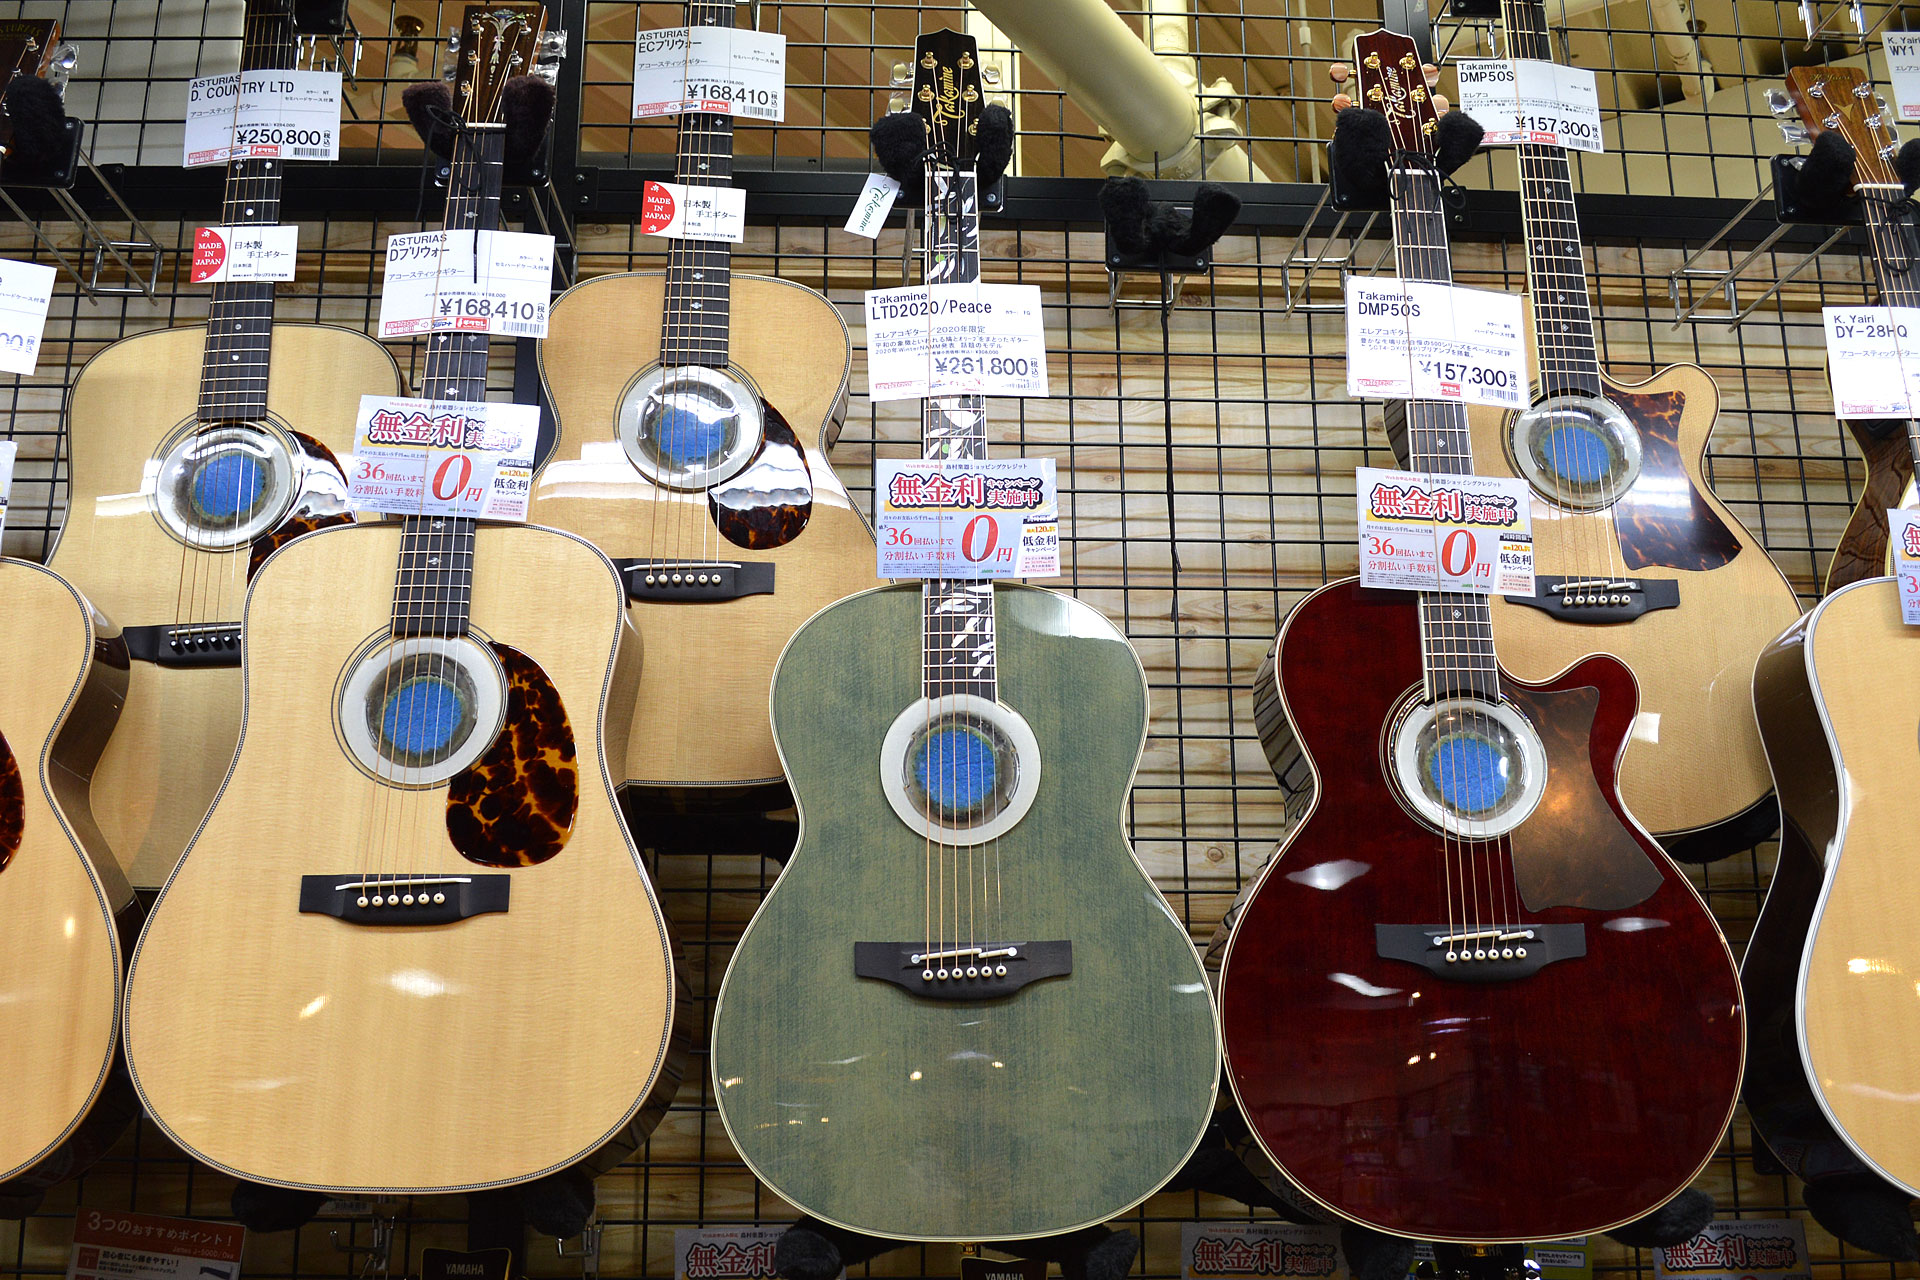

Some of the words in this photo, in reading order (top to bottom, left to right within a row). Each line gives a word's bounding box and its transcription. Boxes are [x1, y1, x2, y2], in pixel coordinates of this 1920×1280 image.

[639, 30, 689, 41] ASTURIAS
[1889, 45, 1915, 56] WY1
[1459, 62, 1508, 71] Takamine
[191, 74, 241, 89] ASTURIAS
[1460, 71, 1515, 83] DMP50S
[206, 81, 266, 99] COUNTRY
[269, 81, 295, 93] LTD
[687, 84, 769, 105] ¥168,410
[933, 65, 966, 127] Takamine
[190, 103, 258, 117] アコースティックギター
[1515, 116, 1591, 138] ¥157,300
[236, 129, 321, 146] ¥250,800
[647, 196, 671, 205] MADE
[683, 200, 711, 209] 日本製
[858, 183, 891, 232] Takamine
[644, 212, 671, 220] JAPAN
[696, 210, 737, 219] 手工ギター
[234, 240, 263, 250] 日本製
[390, 233, 448, 247] ASTURIAS
[247, 250, 289, 259] 手工ギター
[195, 258, 222, 266] JAPAN
[388, 268, 465, 281] アコースティックギター
[871, 292, 928, 305] Takamine
[1358, 290, 1414, 302] Takamine
[440, 298, 534, 320] ¥168,410
[872, 299, 992, 321] LTD2020/Peace
[1358, 302, 1421, 317] DMP50S
[1834, 315, 1846, 324] K.
[1849, 314, 1875, 324] Yairi
[1360, 327, 1412, 336] エレアコギター
[1835, 324, 1908, 339] DY-28HQ
[935, 357, 1029, 377] ¥261,800
[1418, 360, 1508, 388] ¥157,300
[368, 410, 466, 446] 無金利
[494, 477, 529, 491] 低金利
[986, 478, 1040, 488] キャンペーン
[353, 484, 425, 497] 分割払い手数料
[892, 475, 985, 506] 無金利
[986, 489, 1039, 507] 実施中
[1374, 487, 1461, 519] 無金利
[1464, 495, 1515, 506] キャンペーン
[1465, 506, 1515, 524] 実施中
[961, 514, 1013, 563] 0円
[1022, 535, 1057, 547] 低金利
[884, 551, 956, 561] 分割払い手数料
[1441, 529, 1491, 578] 0円
[1500, 553, 1532, 566] 低金利
[1368, 560, 1436, 574] 分割払い手数料
[1196, 1240, 1282, 1272] 無金利
[1666, 1236, 1746, 1267] 無金利
[1750, 1249, 1794, 1265] 実施中
[688, 1244, 777, 1277] 無金利
[1285, 1256, 1333, 1273] 実施中
[445, 1263, 485, 1276] YAMAHA
